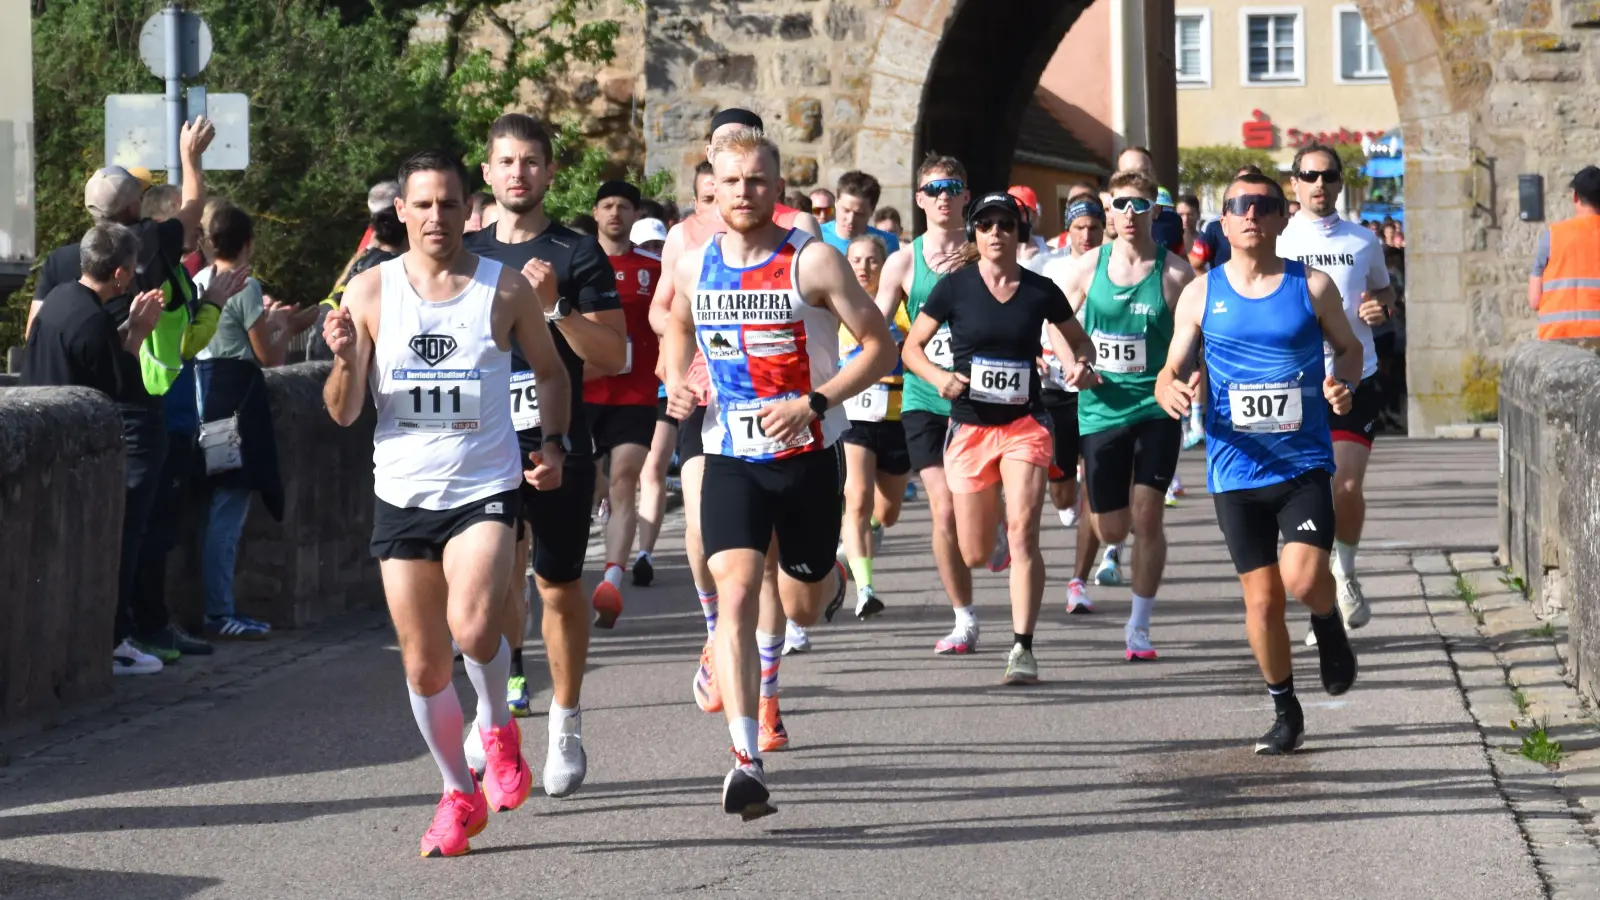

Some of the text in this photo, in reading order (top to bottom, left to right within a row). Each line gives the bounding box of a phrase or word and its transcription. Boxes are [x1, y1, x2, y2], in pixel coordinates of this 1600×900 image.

[696, 293, 792, 310] LA CARRERA
[696, 310, 793, 321] TRITEAM ROTHSEE
[1099, 342, 1136, 361] 515
[981, 370, 1021, 391] 664
[408, 385, 461, 413] 111
[1241, 394, 1289, 418] 307
